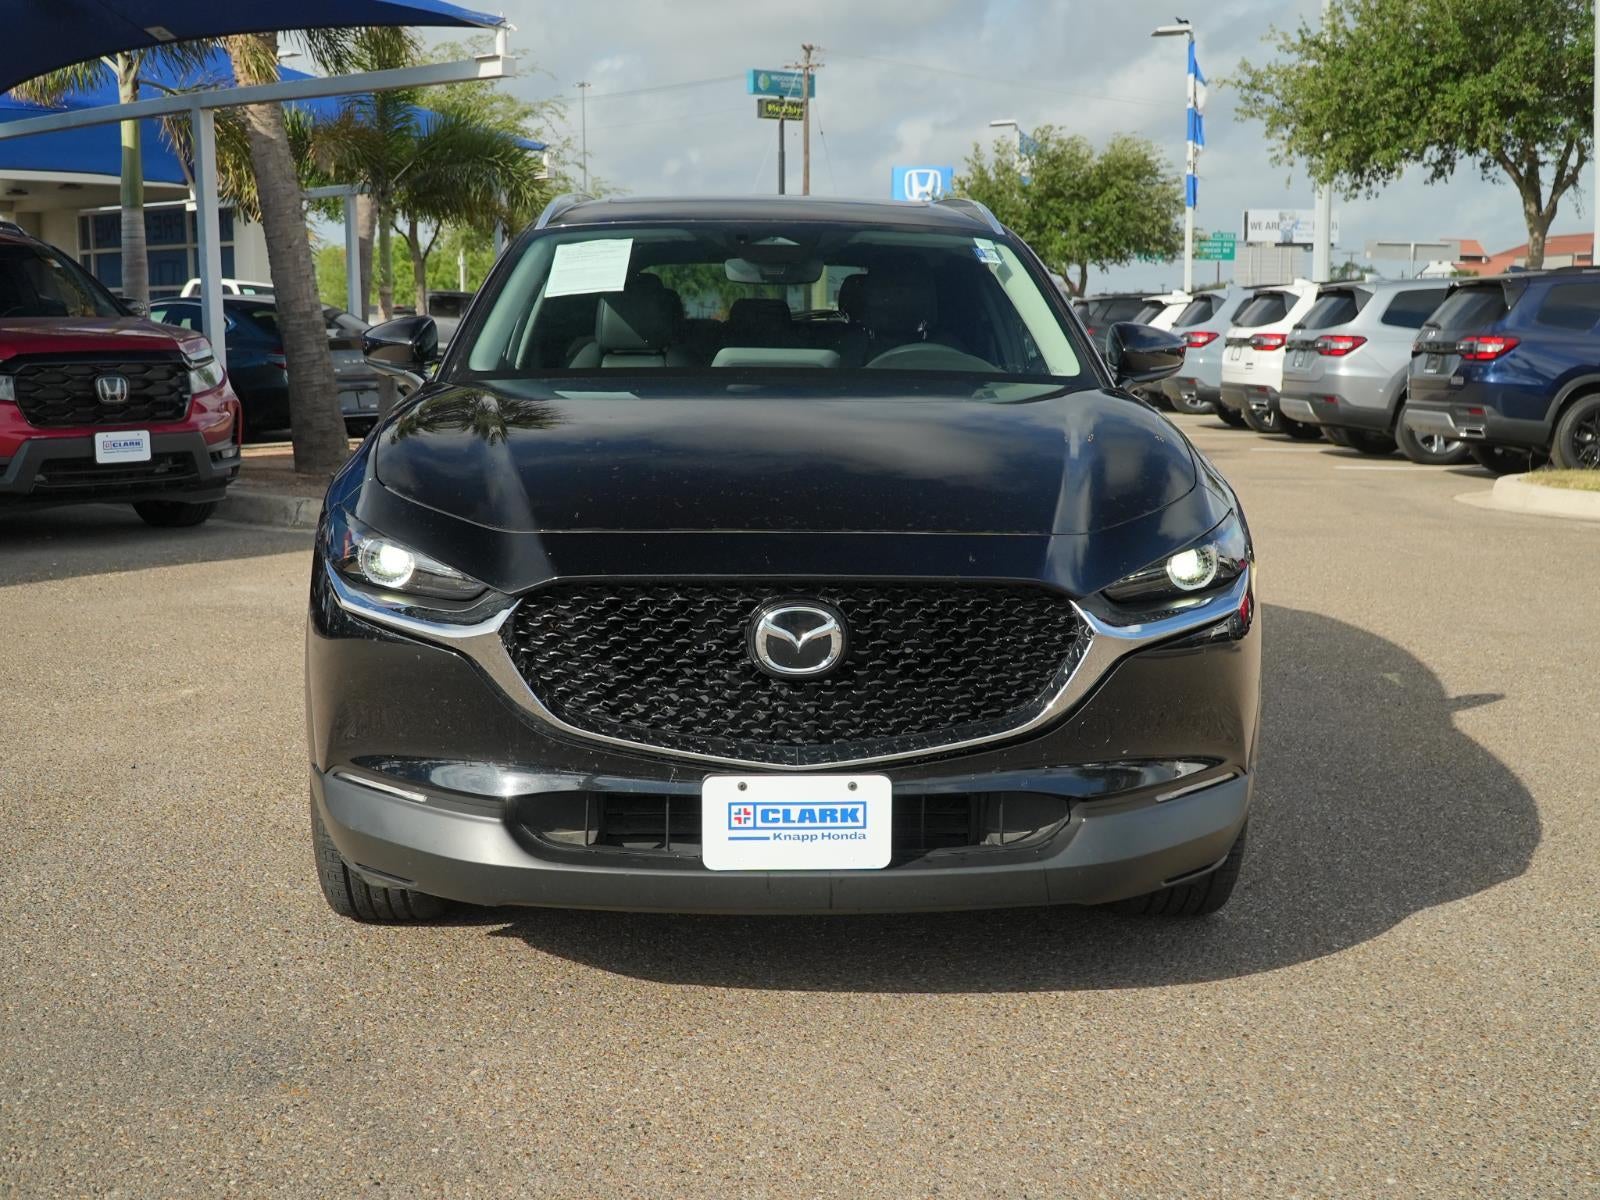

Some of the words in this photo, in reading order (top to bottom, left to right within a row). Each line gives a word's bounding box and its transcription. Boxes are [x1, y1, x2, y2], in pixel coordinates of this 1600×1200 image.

[760, 807, 860, 824] CLARK
[773, 832, 818, 843] Knapp
[821, 831, 867, 841] Honda
